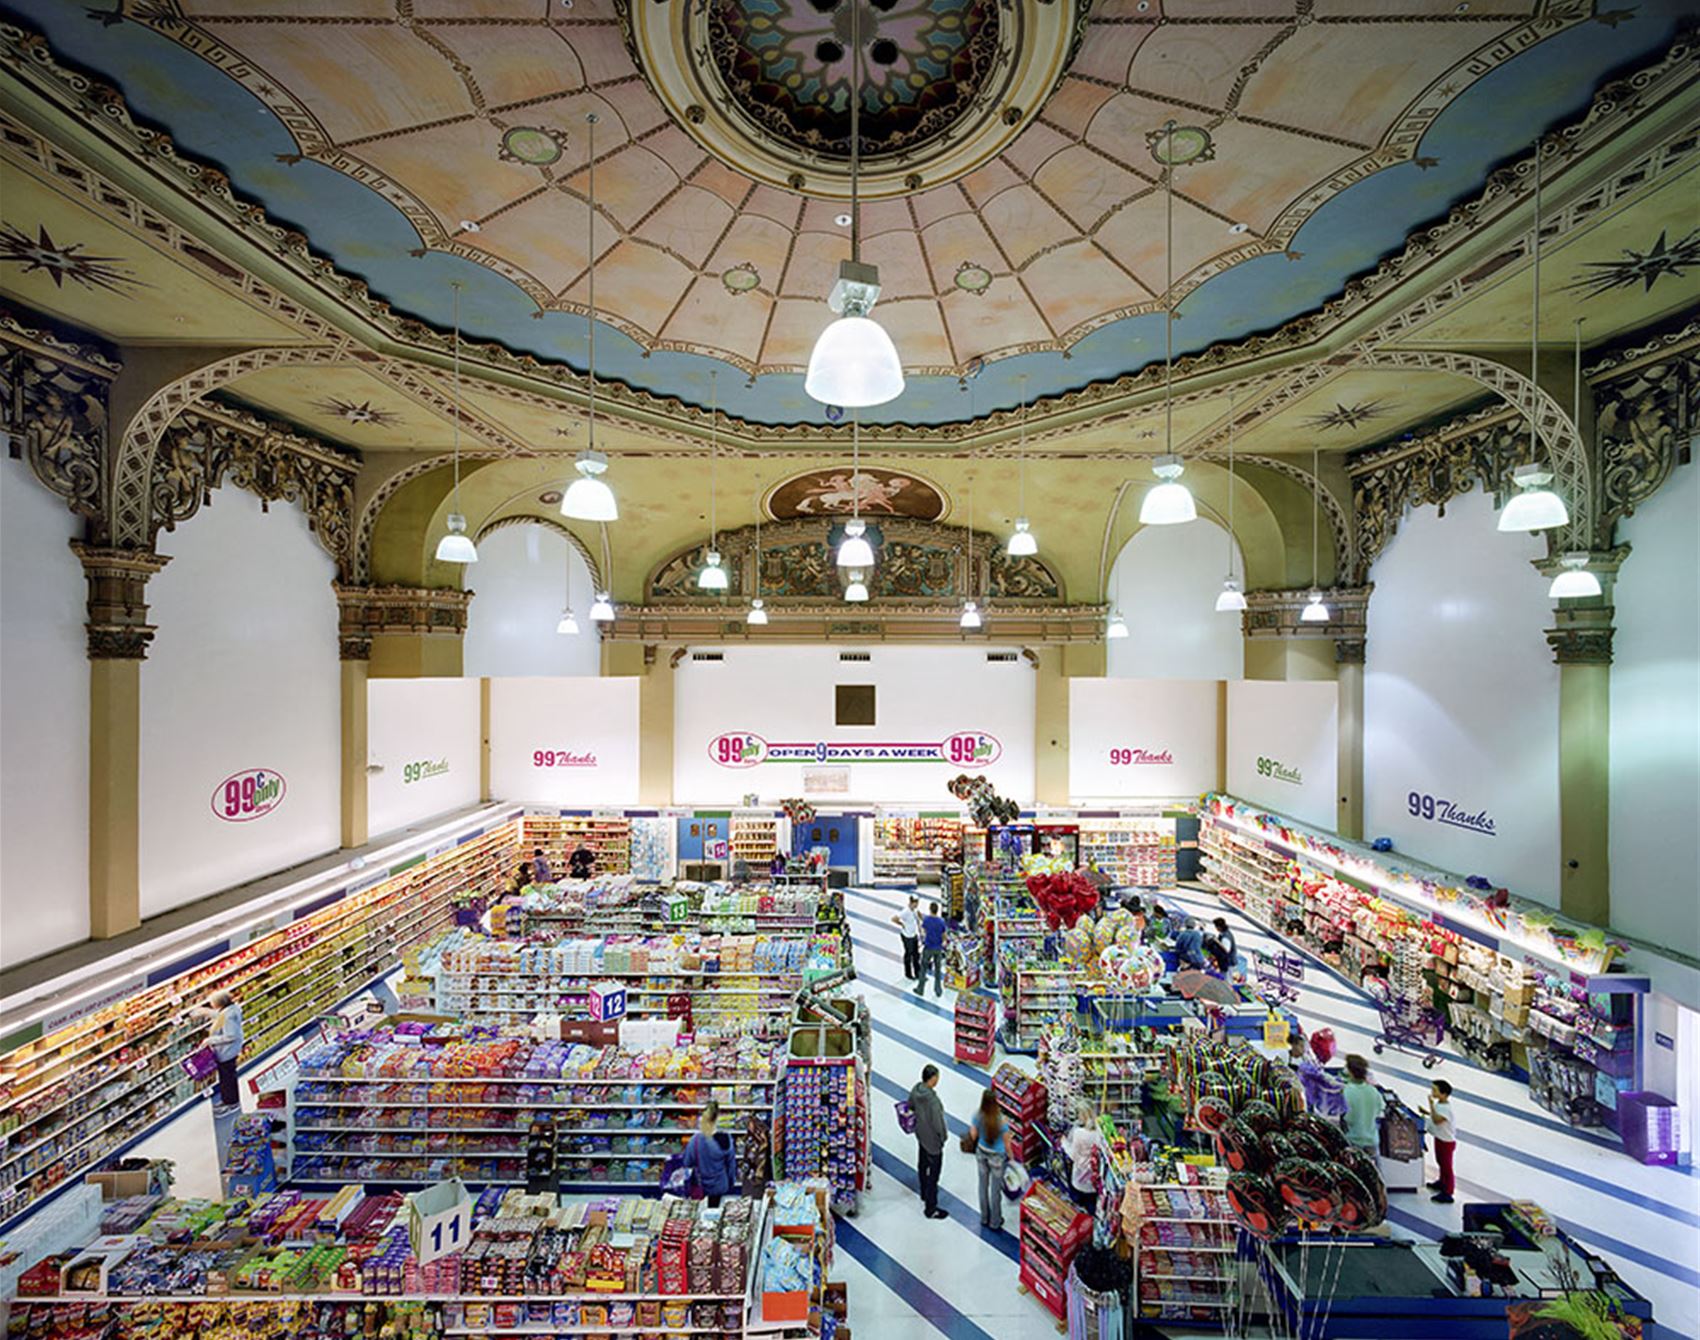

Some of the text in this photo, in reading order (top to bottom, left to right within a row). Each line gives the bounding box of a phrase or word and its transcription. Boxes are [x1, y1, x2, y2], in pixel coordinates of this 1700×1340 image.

[769, 742, 938, 762] OPEN 9 DAYS A WEEK
[606, 994, 623, 1016] 12
[430, 1213, 460, 1252] 11
